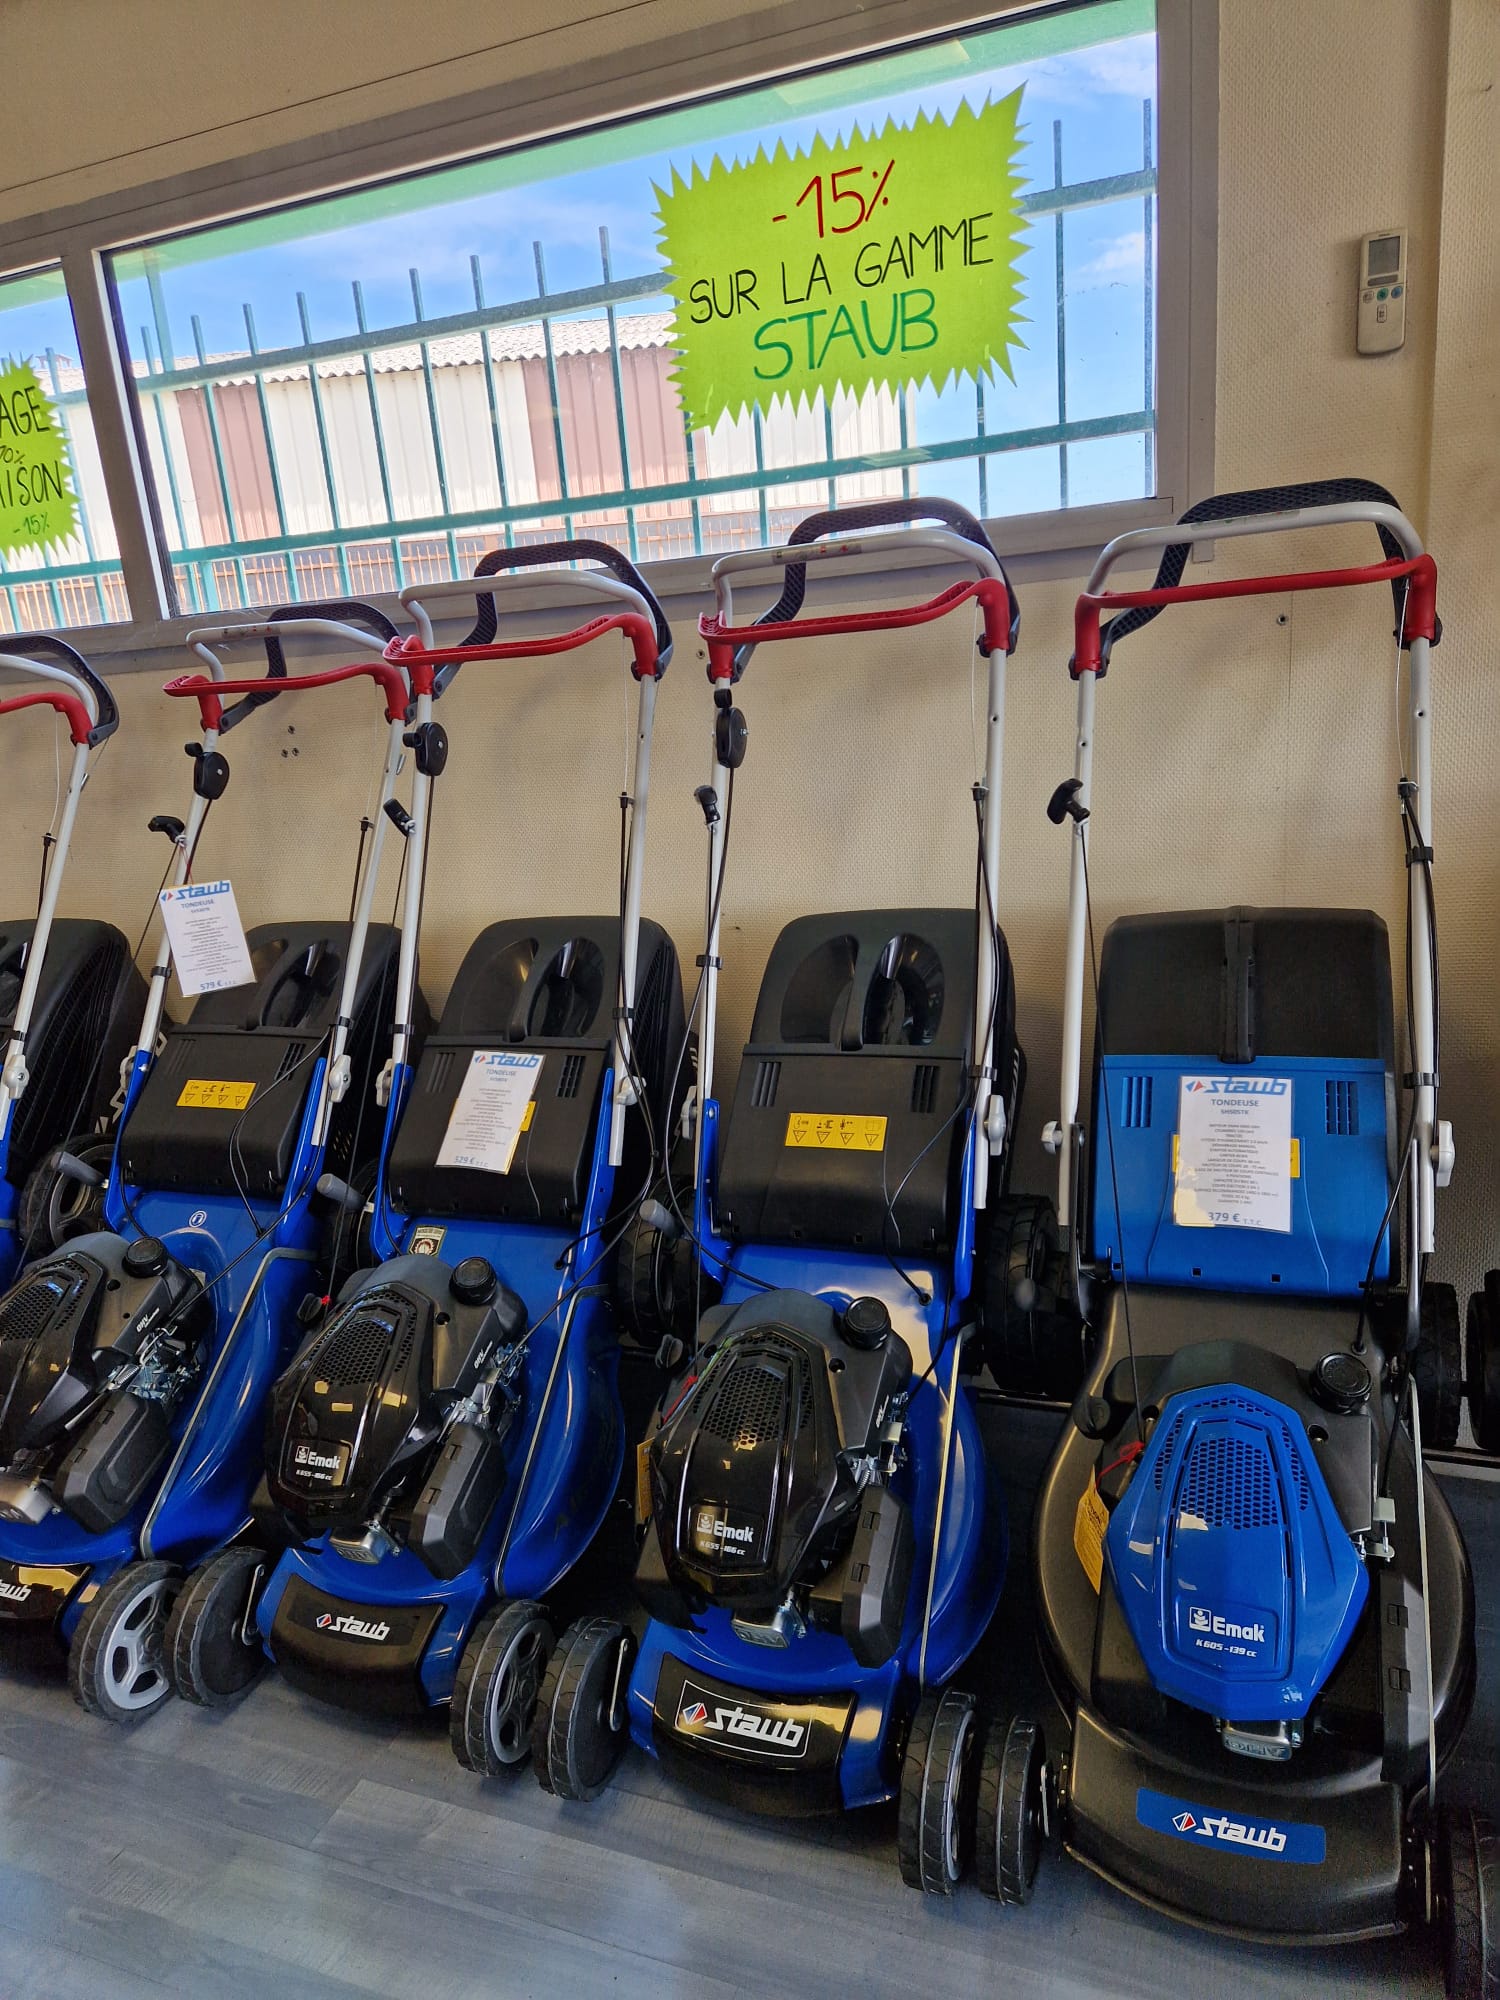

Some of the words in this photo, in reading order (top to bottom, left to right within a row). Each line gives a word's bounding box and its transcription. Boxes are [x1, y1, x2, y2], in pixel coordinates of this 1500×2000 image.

[772, 159, 895, 238] -15%
[689, 269, 760, 324] SUR
[781, 253, 832, 305] LA
[854, 212, 994, 288] GAMME
[753, 288, 939, 381] STAUB
[176, 880, 230, 900] staub
[486, 1053, 540, 1068] staub
[1204, 1077, 1288, 1095] staub
[1211, 1098, 1260, 1107] TONDEUSE
[1208, 1212, 1229, 1222] 379
[1233, 1212, 1241, 1223] €
[308, 1451, 341, 1469] Emak
[713, 1520, 754, 1543] Emak
[328, 1615, 391, 1641] staub
[1212, 1615, 1265, 1643] Emak
[703, 1706, 805, 1748] staub
[1194, 1816, 1287, 1852] staub
